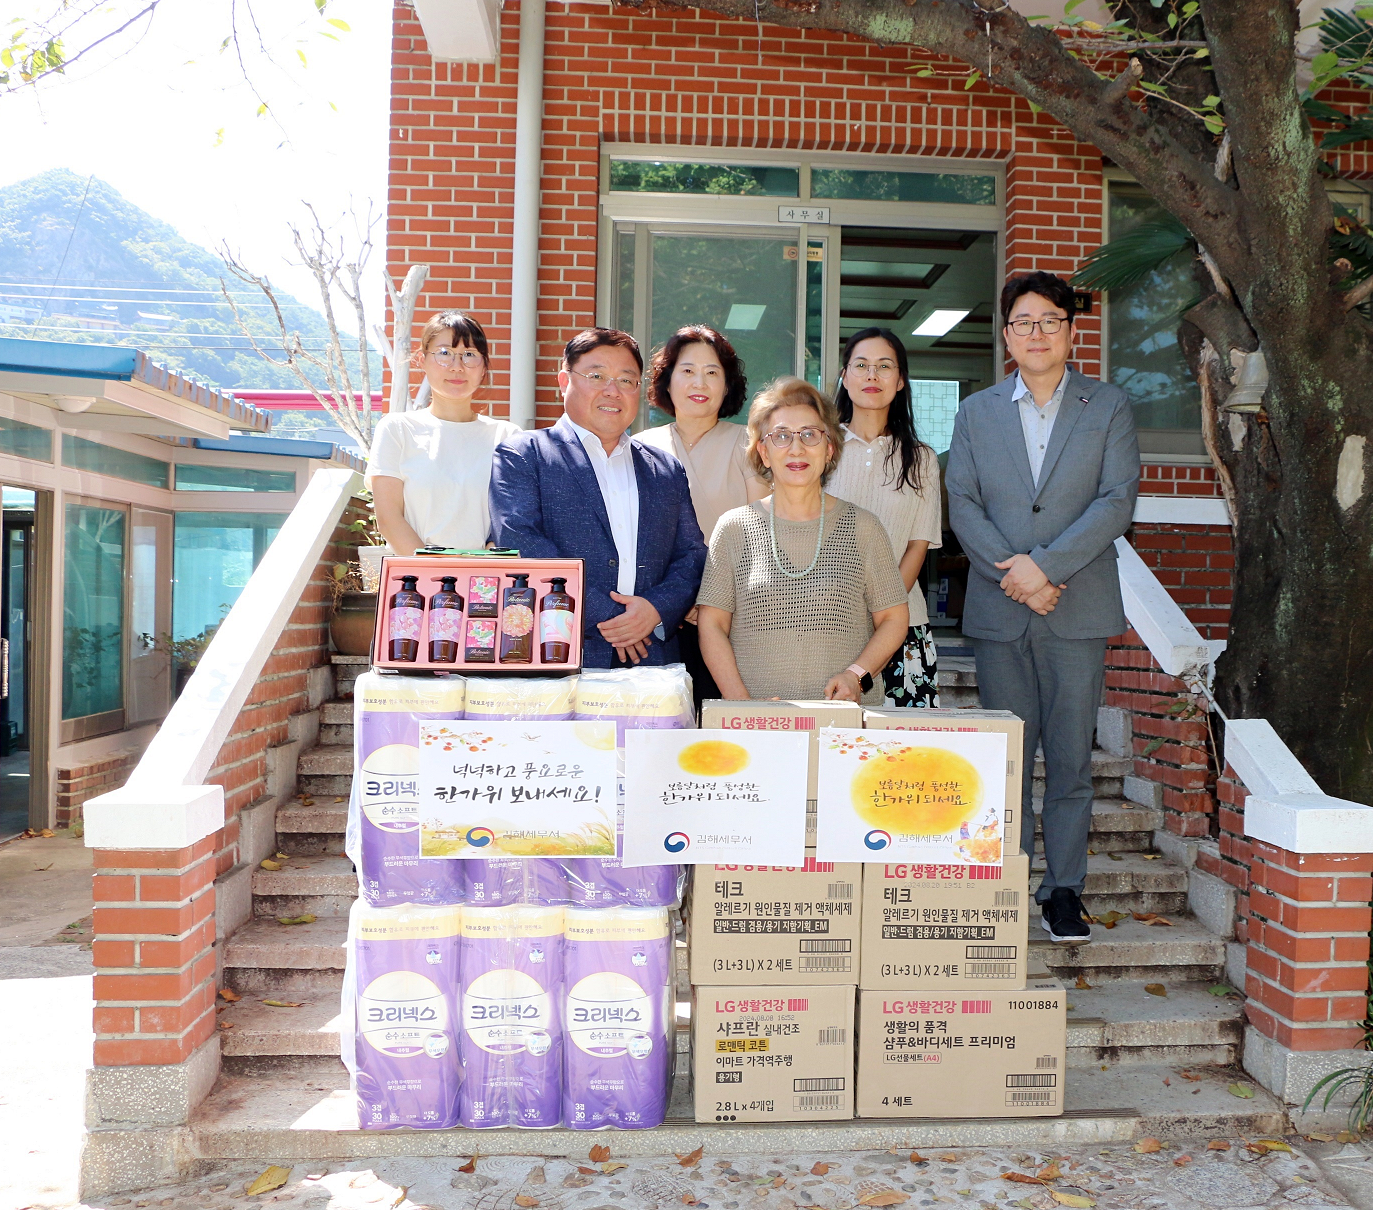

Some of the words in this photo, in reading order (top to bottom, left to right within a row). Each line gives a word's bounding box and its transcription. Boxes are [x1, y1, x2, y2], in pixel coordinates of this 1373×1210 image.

[786, 209, 824, 220] 사무실
[721, 716, 742, 730] LG
[743, 716, 792, 730] 생활건강
[453, 763, 517, 779] 넉넉하고
[522, 762, 584, 780] 풍요로운
[366, 781, 420, 798] 크리넥
[668, 781, 717, 792] 보름달처럼
[722, 781, 760, 792] 풍성한
[879, 779, 925, 791] 보름달처럼
[930, 780, 963, 792] 풍성한
[434, 785, 503, 804] 한가위
[510, 785, 601, 804] 보내세요!
[659, 791, 712, 805] 한가위
[869, 790, 919, 807] 한가위
[696, 834, 752, 845] 김해세무서
[898, 833, 953, 844] 김해세무서
[884, 864, 908, 879] LG
[910, 864, 966, 880] 생활건강
[714, 880, 744, 899] 테크
[883, 887, 912, 905] 테크
[714, 901, 751, 917] 알레르기
[754, 901, 791, 917] 원인물질
[794, 901, 812, 916] 제거
[815, 901, 852, 916] 액체세제
[882, 908, 919, 922] 알레르기
[922, 908, 958, 923] 원인물질
[961, 909, 979, 922] 제거
[982, 909, 1018, 923] 액체세제
[748, 920, 781, 933] 겸용/용기
[916, 926, 948, 939] 겸용/용기
[767, 959, 773, 971] 2
[775, 959, 793, 972] 세트
[933, 965, 939, 976] 2
[942, 964, 959, 977] 세트
[470, 1004, 540, 1020] 크리넥스
[715, 1000, 736, 1013] LG
[737, 999, 785, 1012] 생활건강
[883, 1001, 904, 1014] LG
[905, 1000, 957, 1014] 생활건강
[1008, 1000, 1058, 1010] 11001884
[367, 1006, 438, 1022] 크리넥스
[573, 1007, 642, 1023] 크리넥스
[716, 1021, 761, 1037] 샤프란
[763, 1023, 800, 1037] 실내건조
[883, 1021, 919, 1034] 생활의
[923, 1020, 948, 1034] 품격
[589, 1031, 603, 1040] 순수
[883, 1036, 965, 1050] 샴푸&바디세트
[968, 1035, 1016, 1049] 프리미엄
[717, 1040, 746, 1053] 로맨틱
[748, 1039, 767, 1052] 코튼
[716, 1056, 744, 1068] 이마트
[746, 1054, 793, 1067] 가격역주행
[717, 1072, 741, 1083] 용기형
[716, 1101, 732, 1112] 2.8
[749, 1100, 774, 1112] 4개입
[881, 1096, 889, 1106] 4
[892, 1096, 913, 1107] 세트
[575, 1111, 586, 1119] 30
